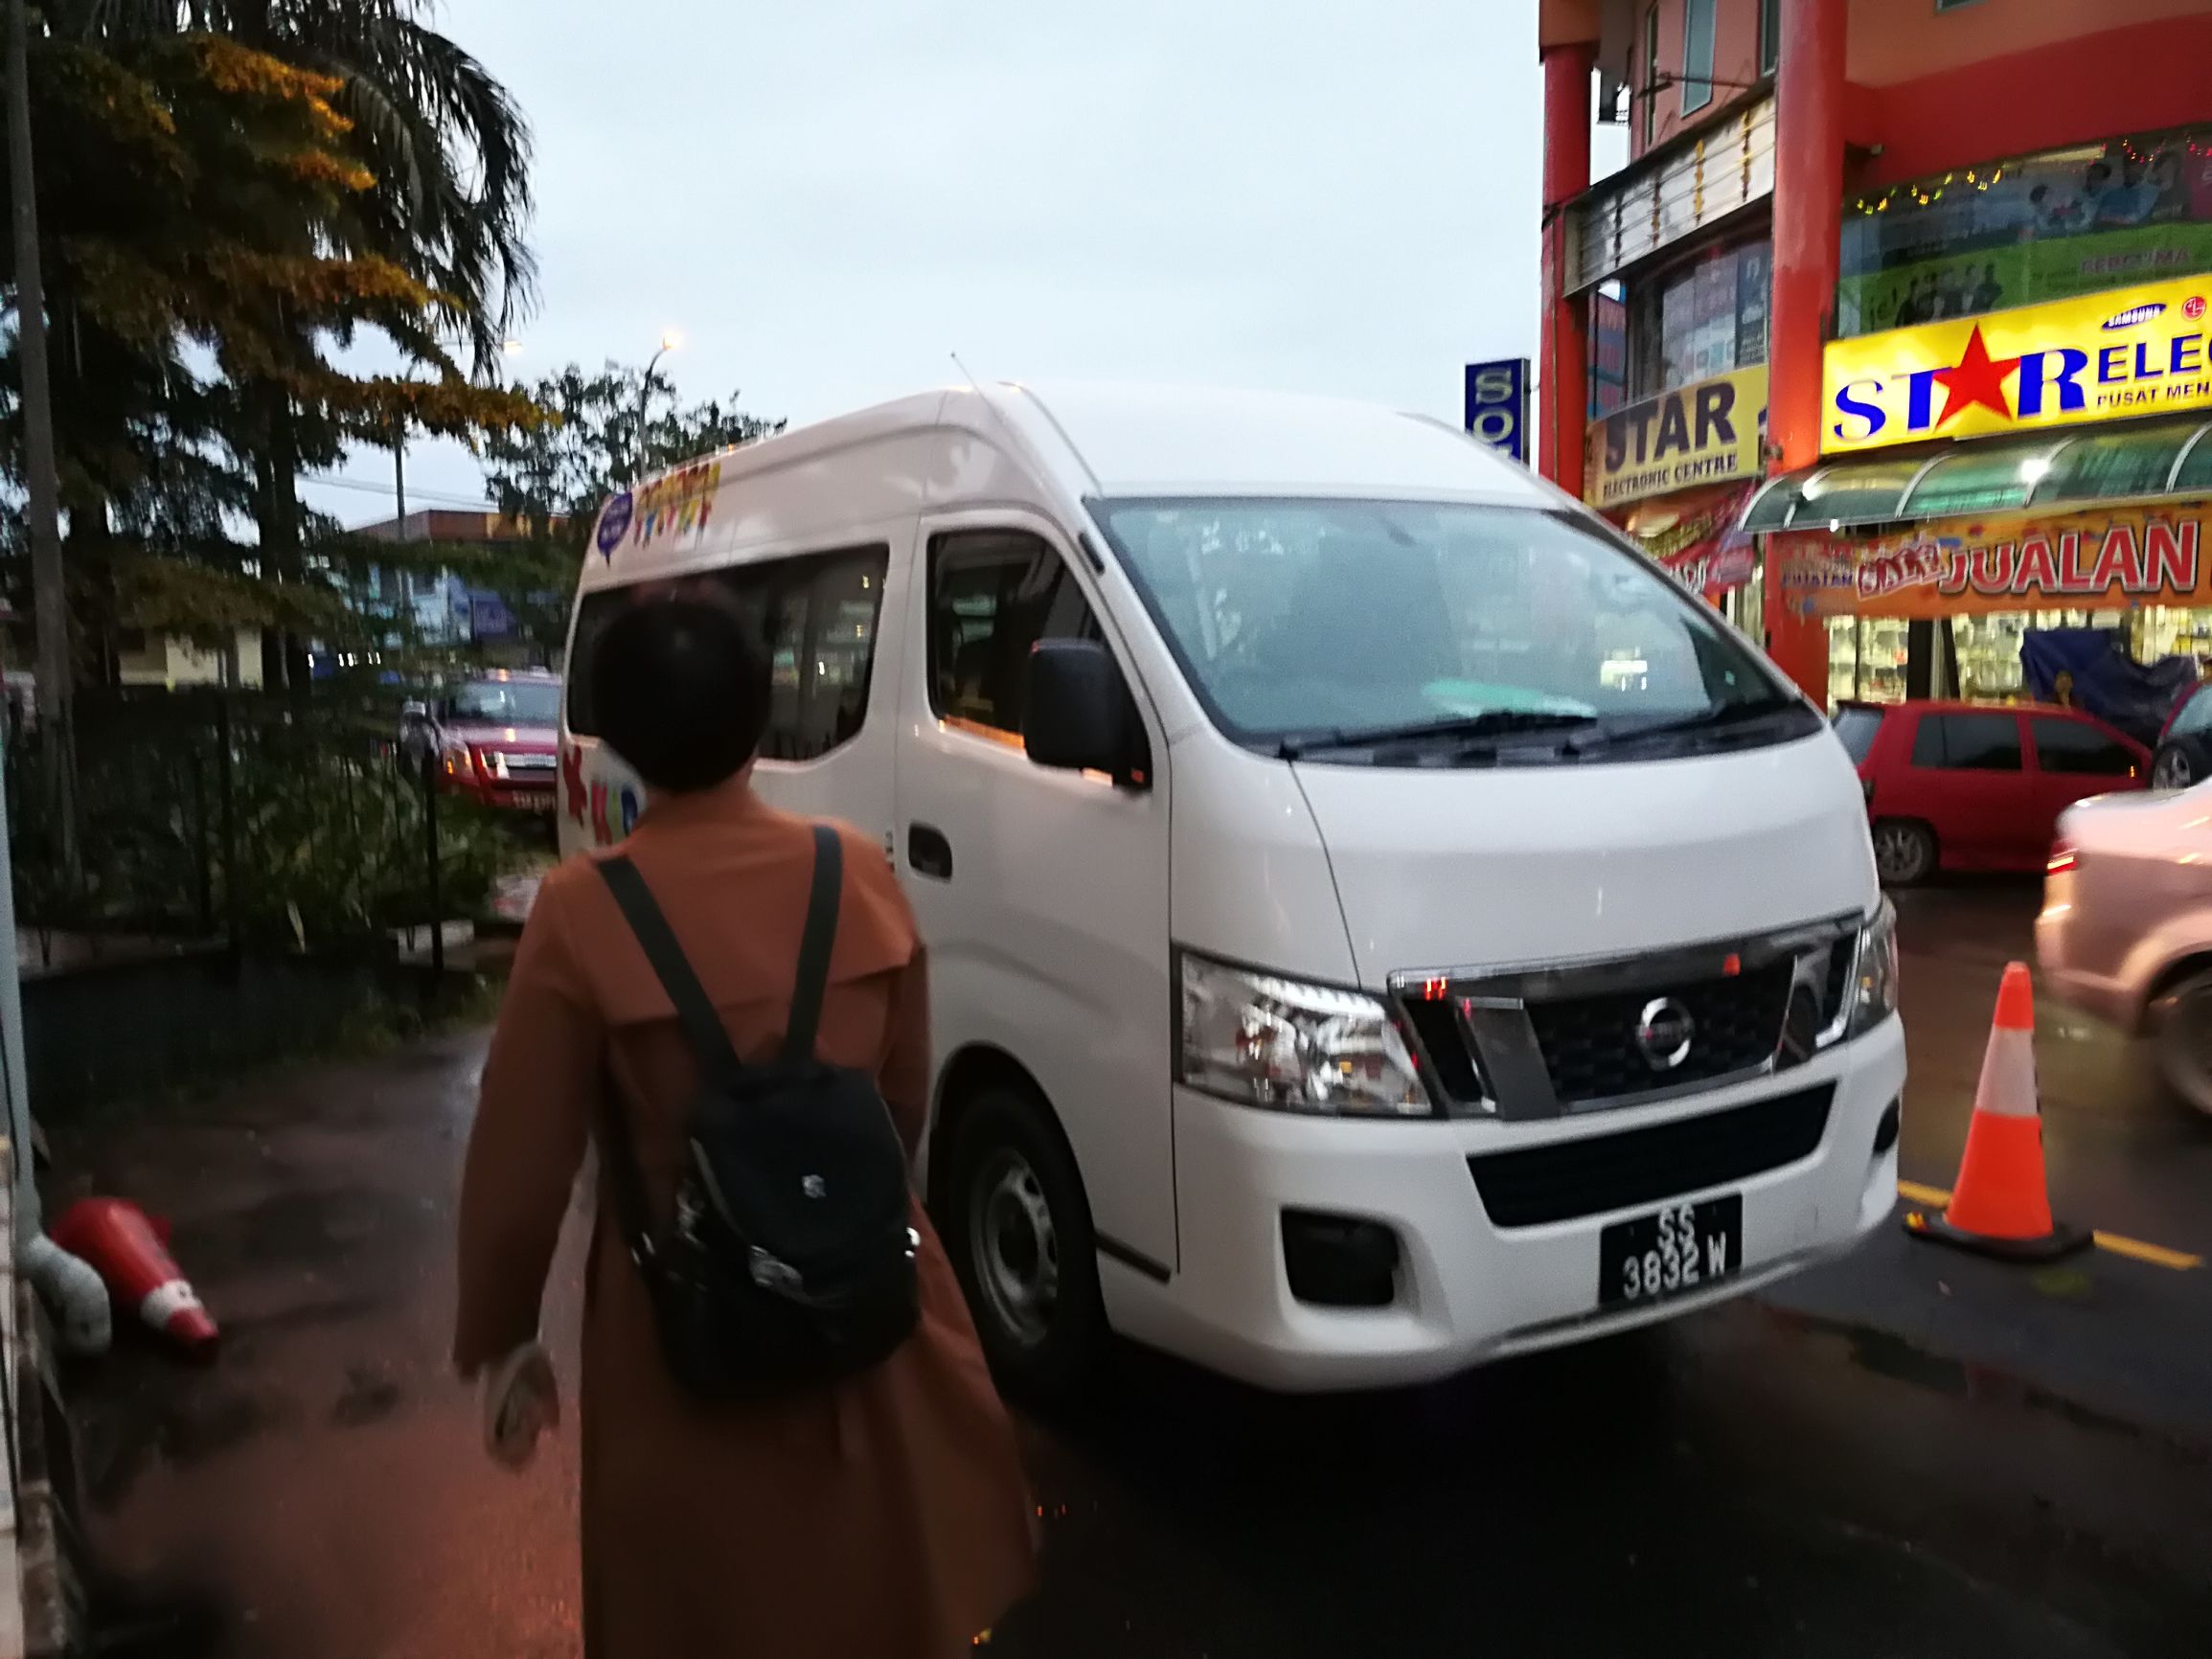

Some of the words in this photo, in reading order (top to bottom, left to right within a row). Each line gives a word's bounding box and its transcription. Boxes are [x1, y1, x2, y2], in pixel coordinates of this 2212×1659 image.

[2107, 304, 2162, 328] SAMSUNG
[2098, 333, 2212, 384] ELE
[1473, 367, 1514, 459] SO
[2097, 388, 2158, 408] PUSAT
[2166, 381, 2209, 400] MEN
[1674, 453, 1737, 483] CENTRE
[1939, 519, 2199, 594] JUALAN
[1657, 1203, 1696, 1250] SS
[1623, 1241, 1700, 1300] 3832
[1707, 1231, 1726, 1278] W
